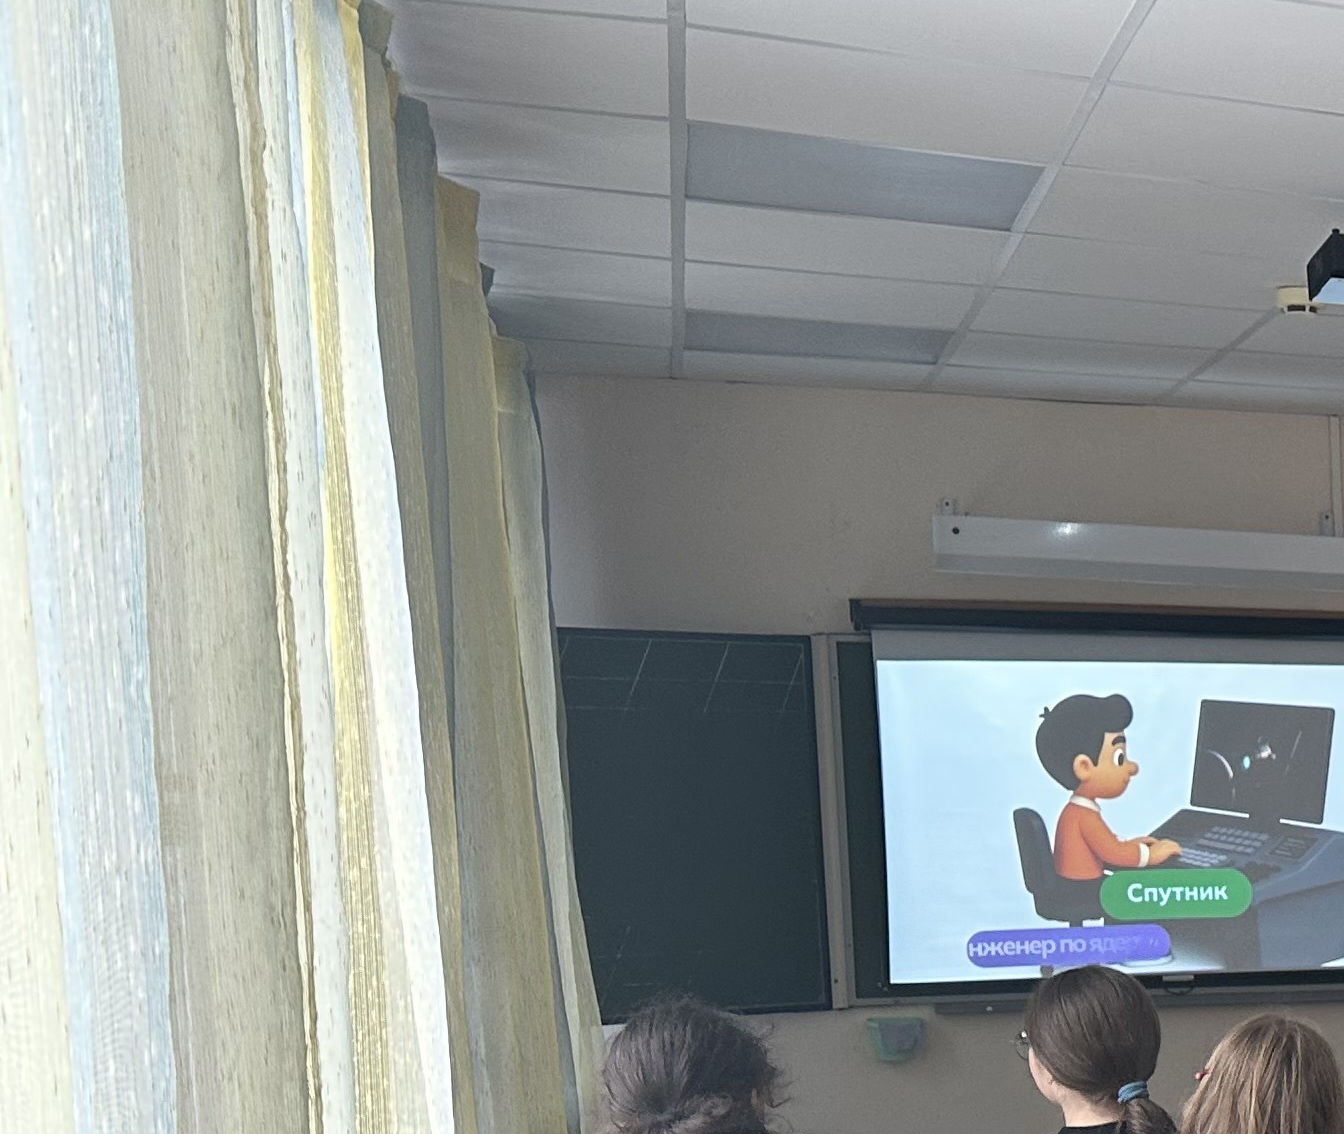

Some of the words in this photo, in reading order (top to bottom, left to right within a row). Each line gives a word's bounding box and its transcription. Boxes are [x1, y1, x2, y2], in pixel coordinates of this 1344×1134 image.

[1127, 882, 1228, 907] Спутник
[968, 937, 1056, 959] нженер
[1060, 936, 1088, 954] по
